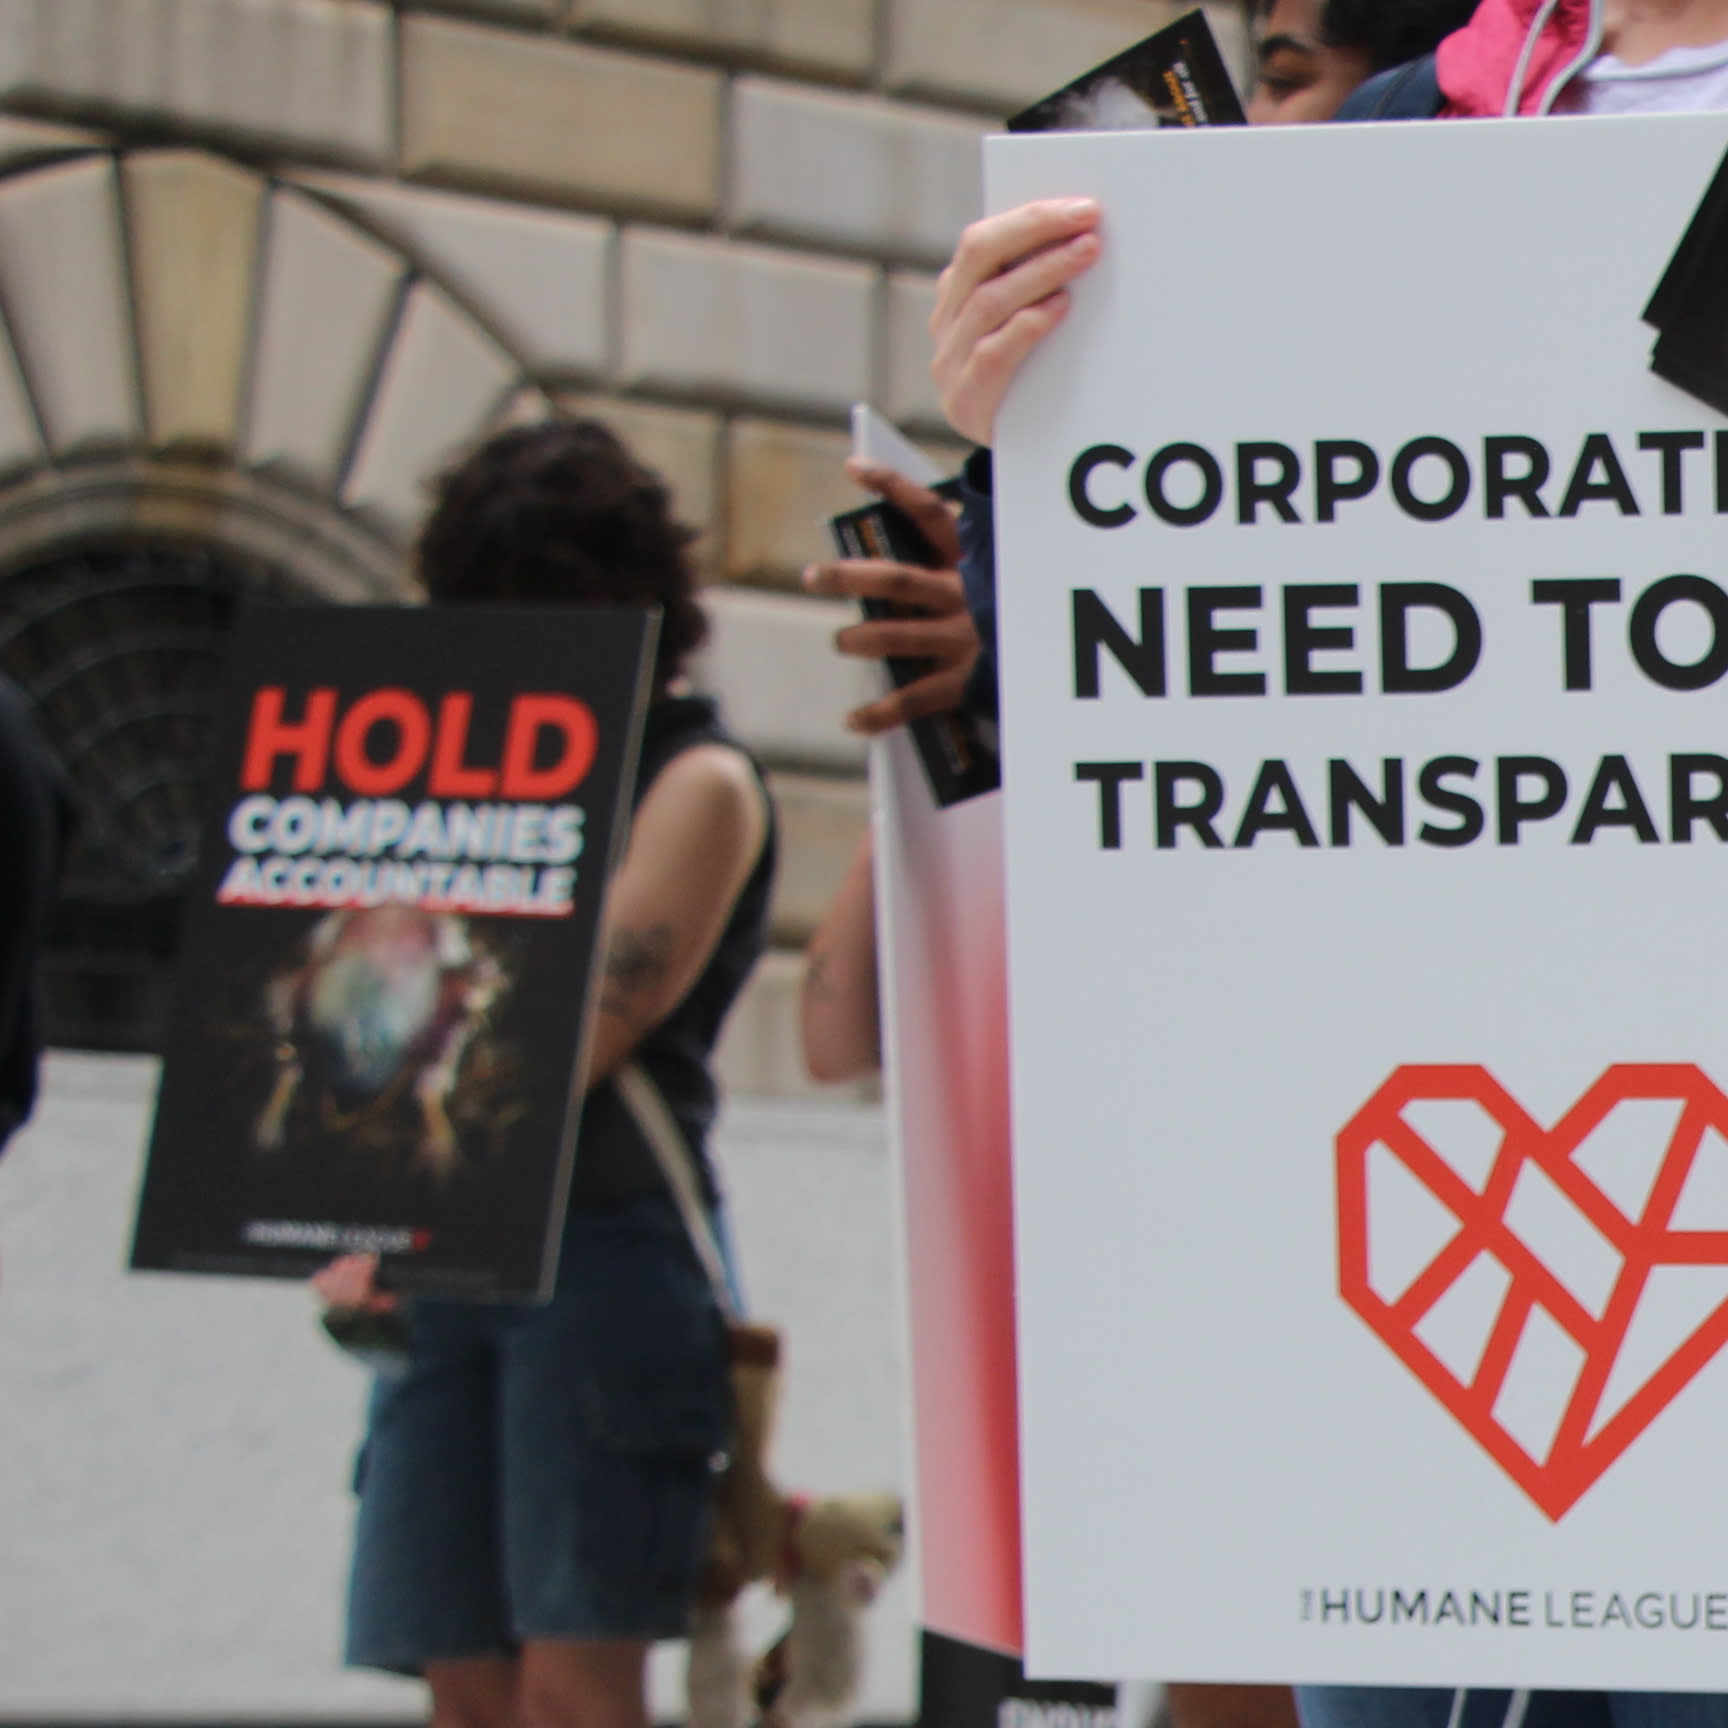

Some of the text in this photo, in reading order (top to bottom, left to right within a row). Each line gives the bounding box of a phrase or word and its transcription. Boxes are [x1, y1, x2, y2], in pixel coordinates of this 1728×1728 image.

[1072, 580, 1484, 700] NEED
[241, 686, 598, 799] HOLD
[227, 794, 585, 865] COMPANIES
[221, 858, 574, 907] ACCOUNTABLE
[1320, 1587, 1532, 1629] HUMANE
